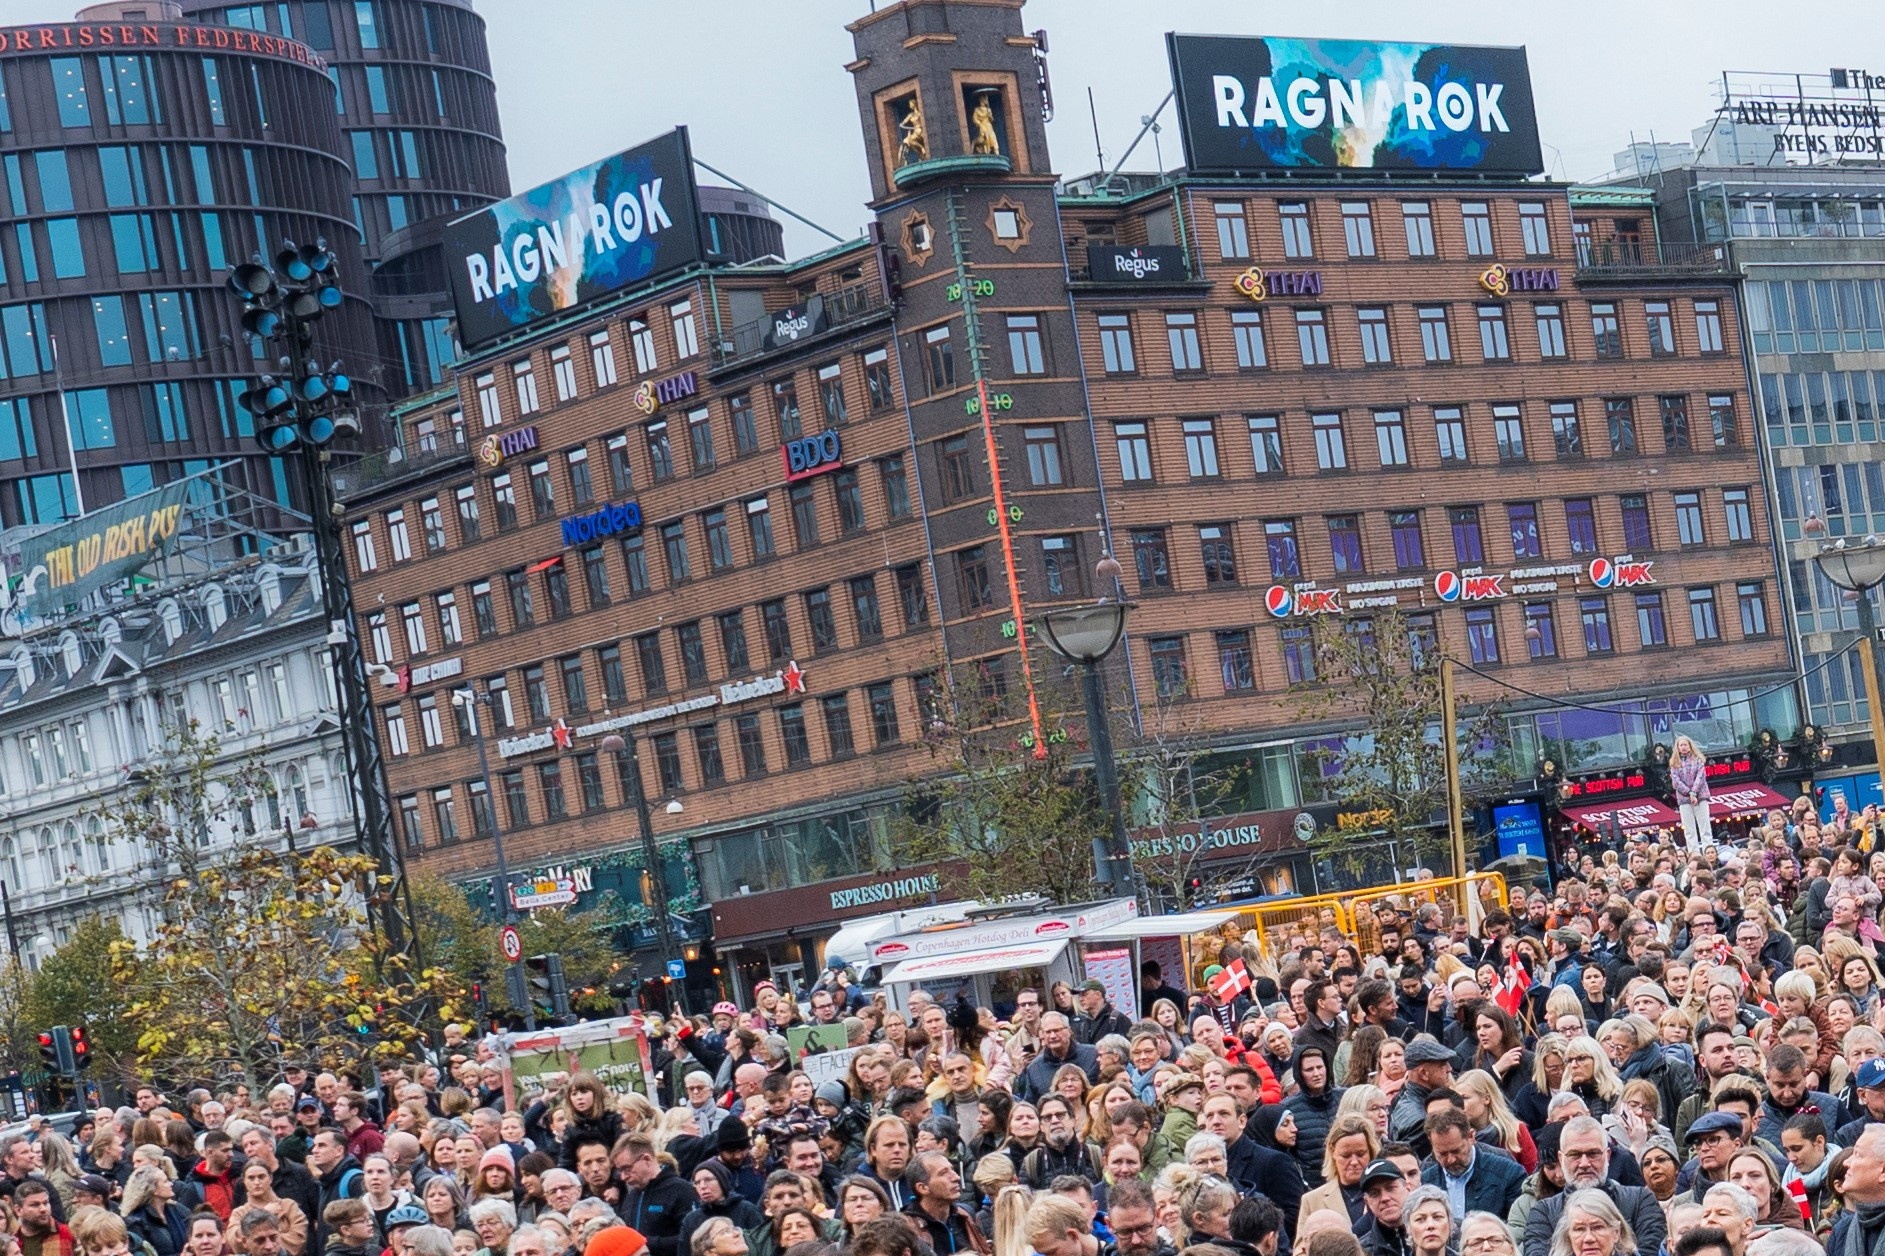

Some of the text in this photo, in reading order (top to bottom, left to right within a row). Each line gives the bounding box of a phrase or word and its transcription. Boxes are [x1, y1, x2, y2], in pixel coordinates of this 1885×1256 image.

[1848, 69, 1885, 90] The
[1212, 75, 1511, 133] RAGNAROK
[1774, 133, 1828, 153] BYENS
[466, 177, 673, 304] RAGNAROK
[1114, 254, 1160, 278] Regus
[975, 279, 995, 296] 20
[1264, 271, 1322, 295] THAI
[1508, 269, 1560, 291] THAI
[775, 315, 809, 340] Regus
[655, 372, 697, 405] THAI
[500, 427, 538, 458] THAI
[787, 429, 839, 472] BDO
[561, 503, 641, 547] Nordea
[77, 532, 101, 578] OLD
[102, 514, 147, 565] IRISH
[1706, 788, 1768, 806] COTTISH
[1580, 803, 1661, 824] SCOTISH
[830, 881, 893, 910] ESPRESSO
[915, 926, 1030, 956] Copenhagen Hotdog Deli
